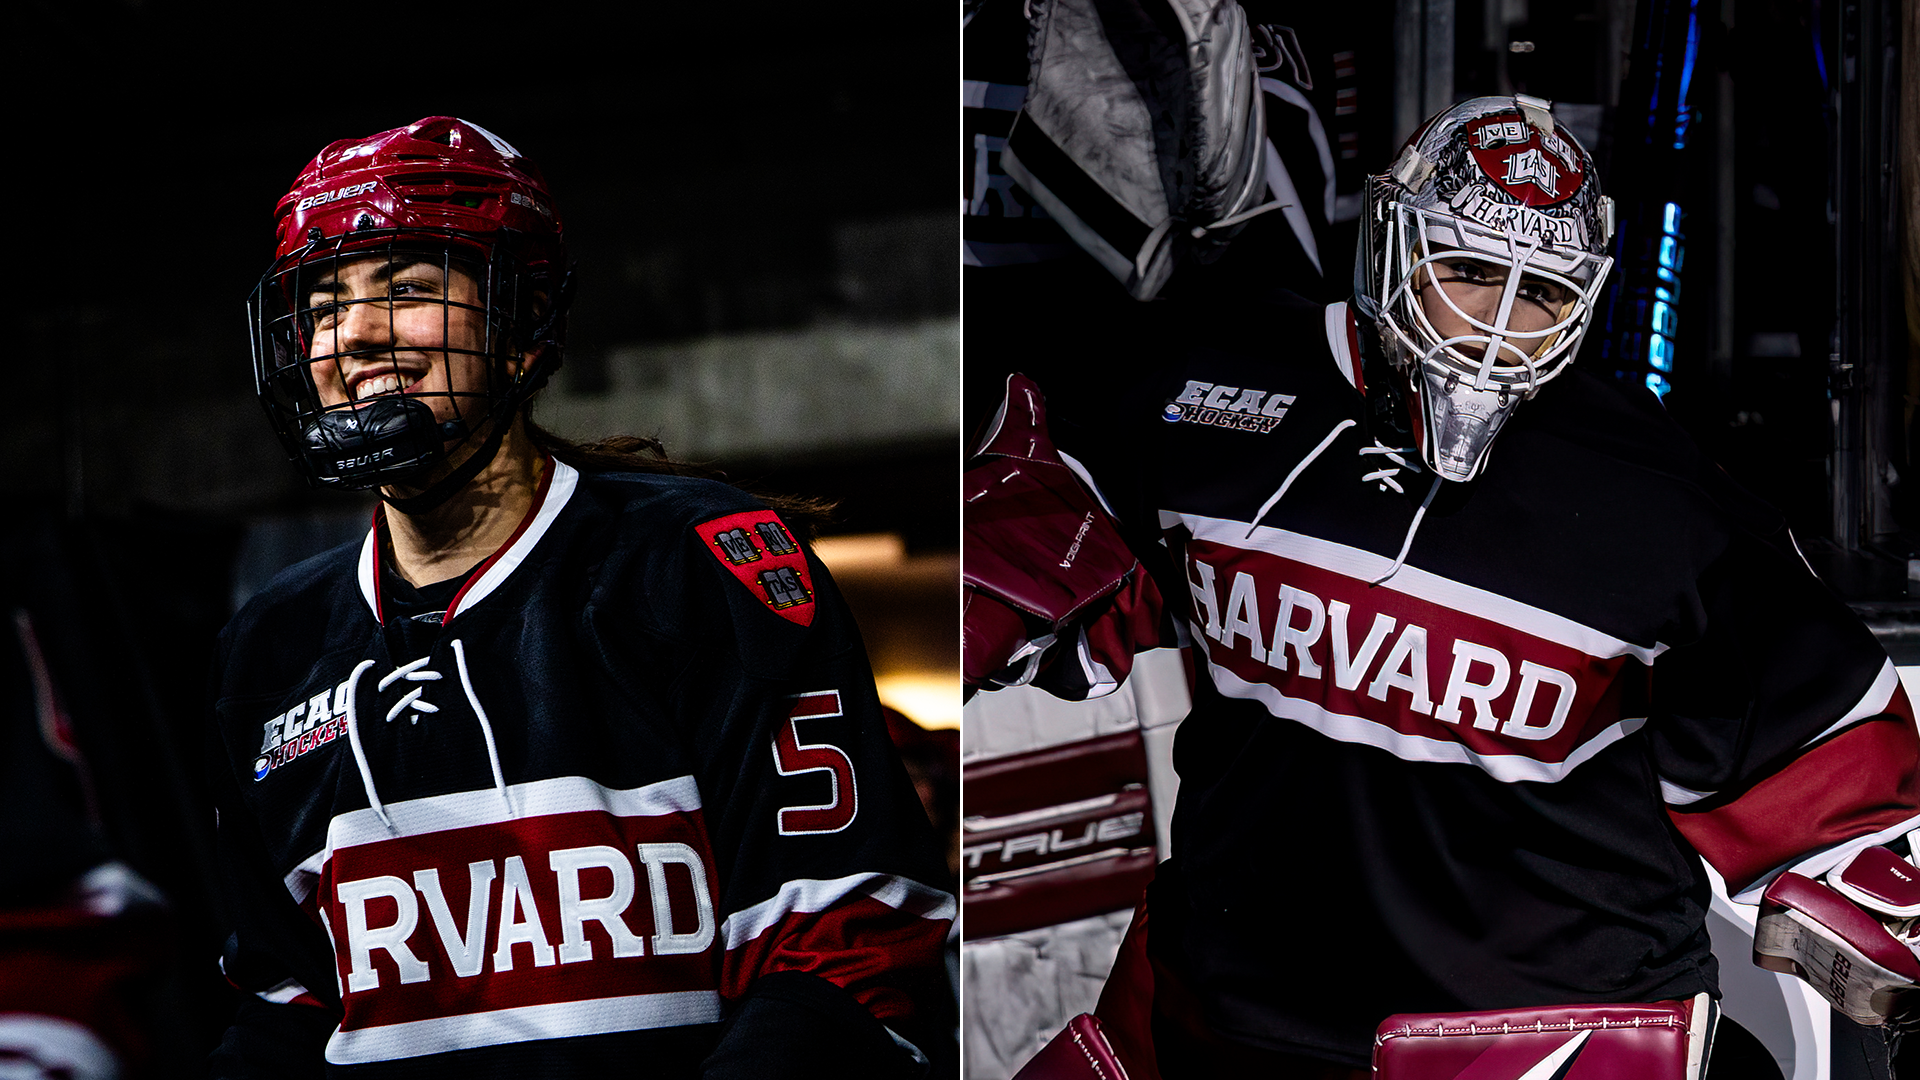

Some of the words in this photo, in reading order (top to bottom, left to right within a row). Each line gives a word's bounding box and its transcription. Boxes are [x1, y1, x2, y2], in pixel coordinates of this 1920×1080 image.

[297, 180, 378, 212] BAUER
[1472, 200, 1573, 243] HARVARD
[1175, 380, 1297, 419] ECAC
[1183, 405, 1282, 434] HOCKEY
[768, 575, 798, 595] TAS
[1187, 554, 1578, 741] HARVARD
[769, 688, 859, 837] 5
[963, 811, 1145, 870] TRUE
[319, 841, 717, 999] RVARD
[1828, 950, 1852, 1009] BAUER
